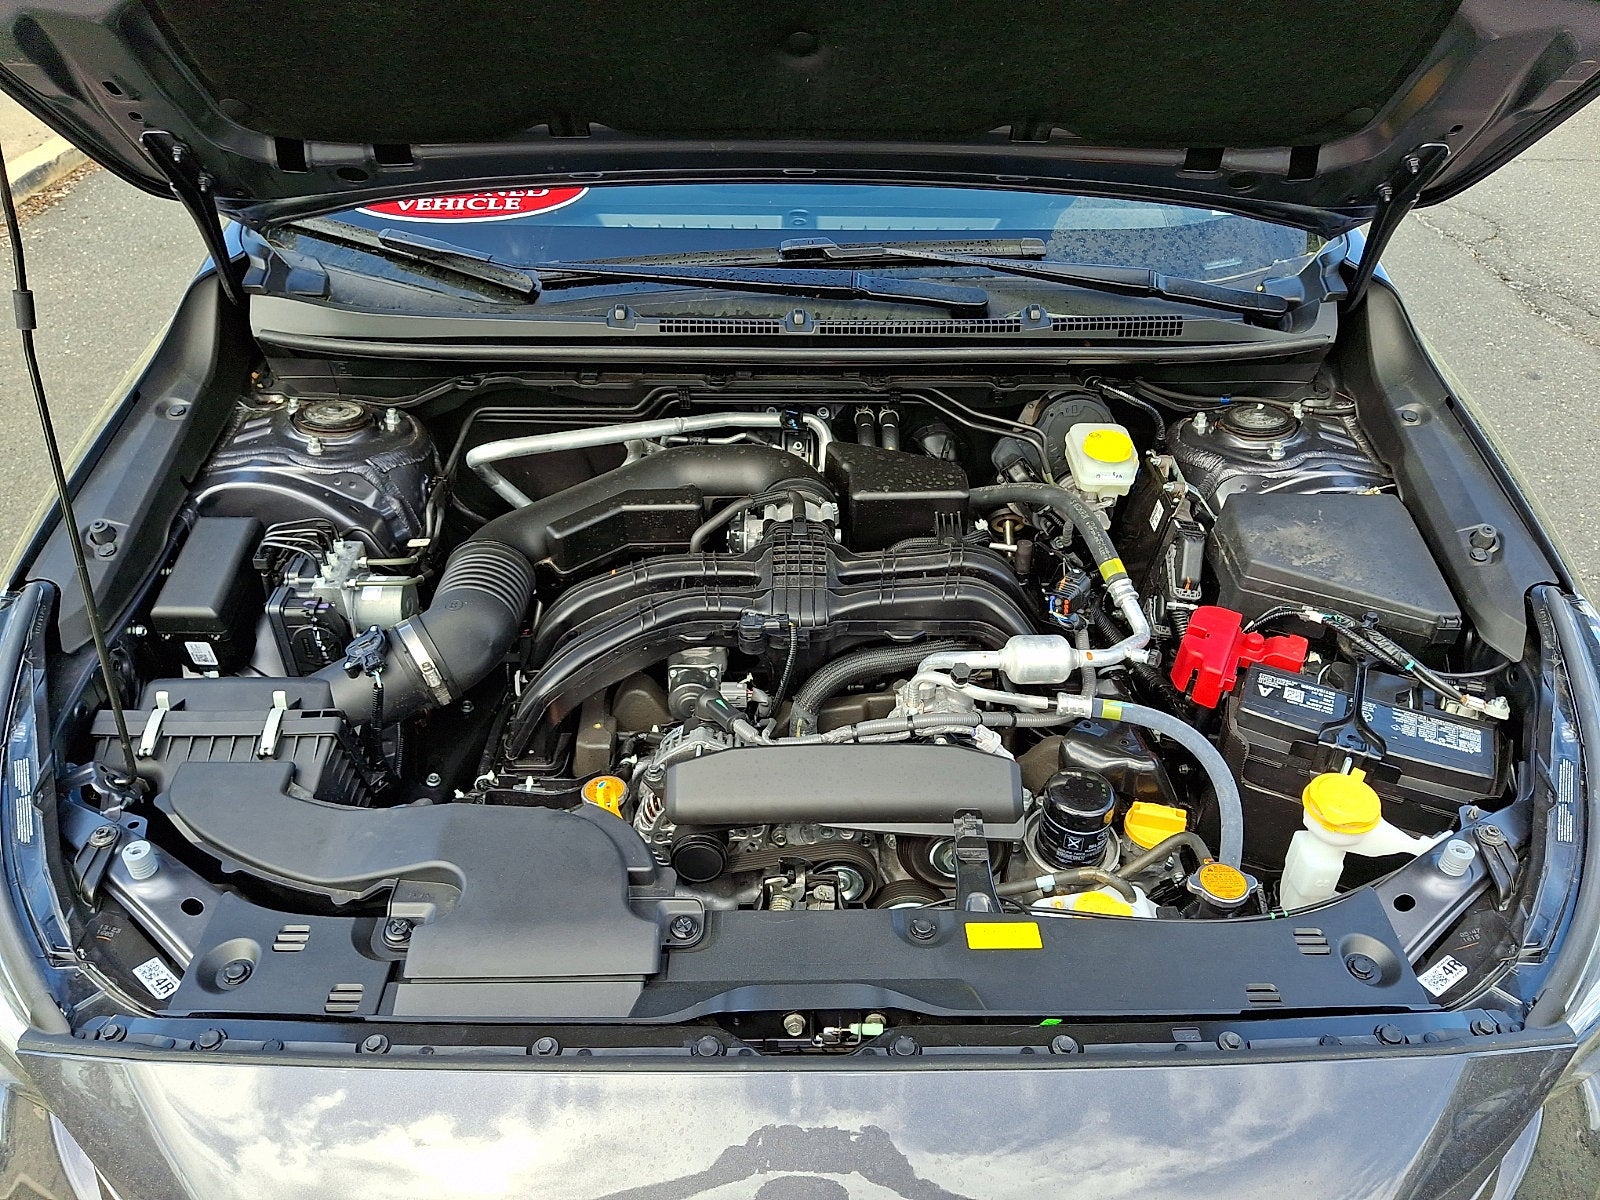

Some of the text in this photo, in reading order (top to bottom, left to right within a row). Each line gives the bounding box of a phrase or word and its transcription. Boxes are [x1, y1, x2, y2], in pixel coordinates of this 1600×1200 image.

[397, 198, 521, 210] VEHICLE
[1442, 959, 1462, 975] 4R
[156, 978, 175, 995] 4R
